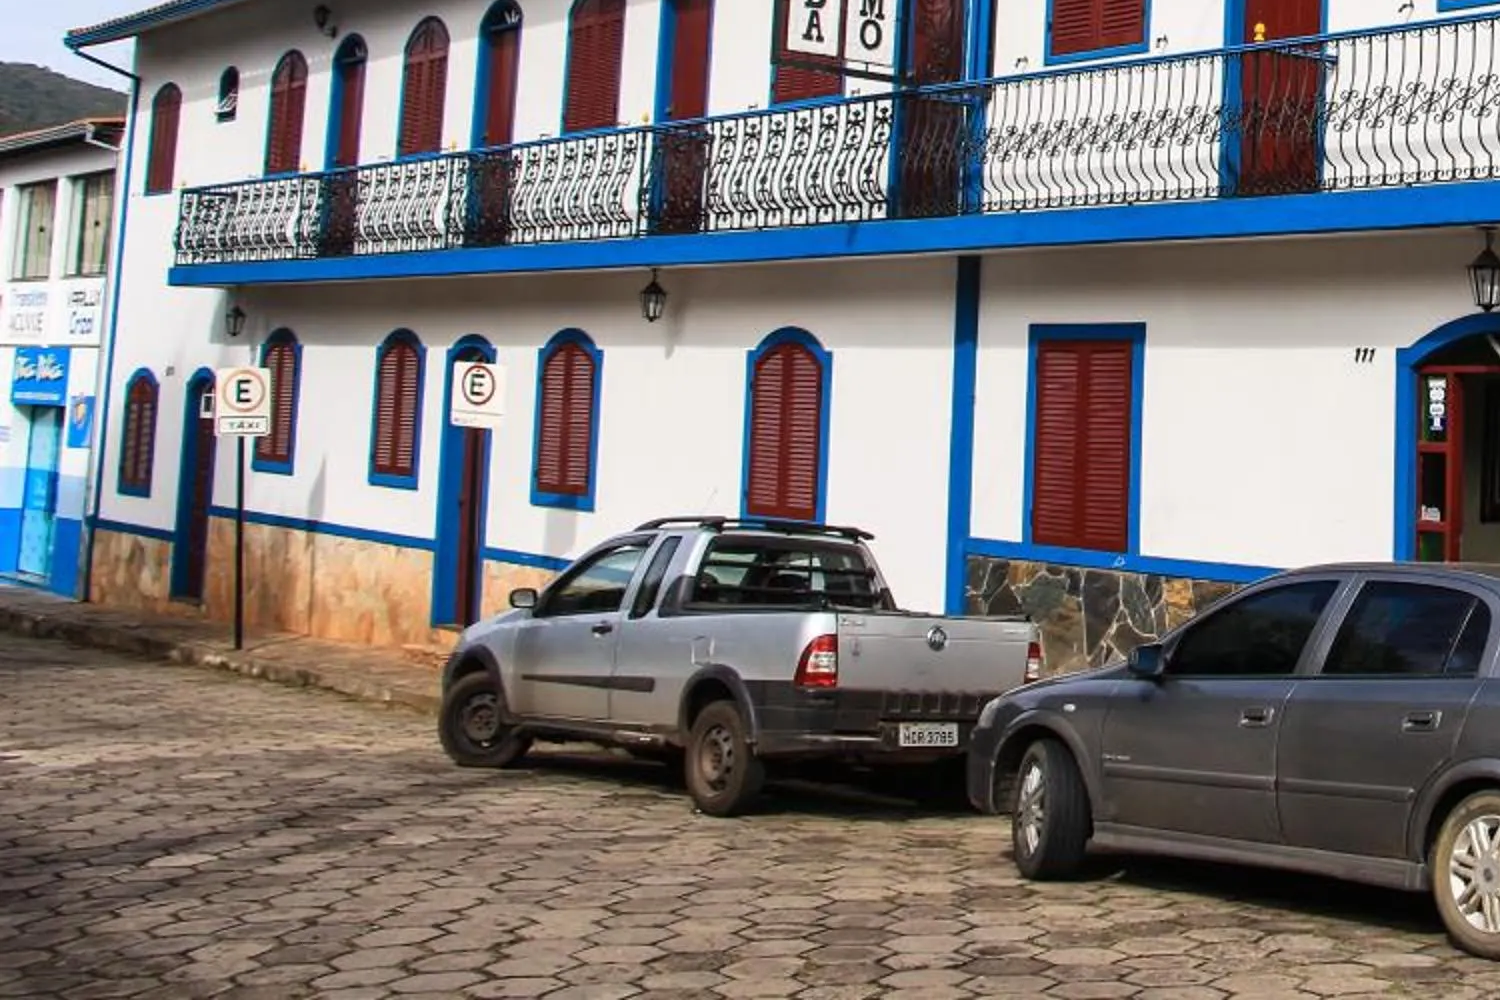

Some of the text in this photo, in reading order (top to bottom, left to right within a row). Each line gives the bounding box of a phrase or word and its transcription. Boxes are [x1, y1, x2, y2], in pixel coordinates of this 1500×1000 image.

[1355, 347, 1376, 363] 111
[236, 379, 252, 403] E
[470, 373, 486, 396] E
